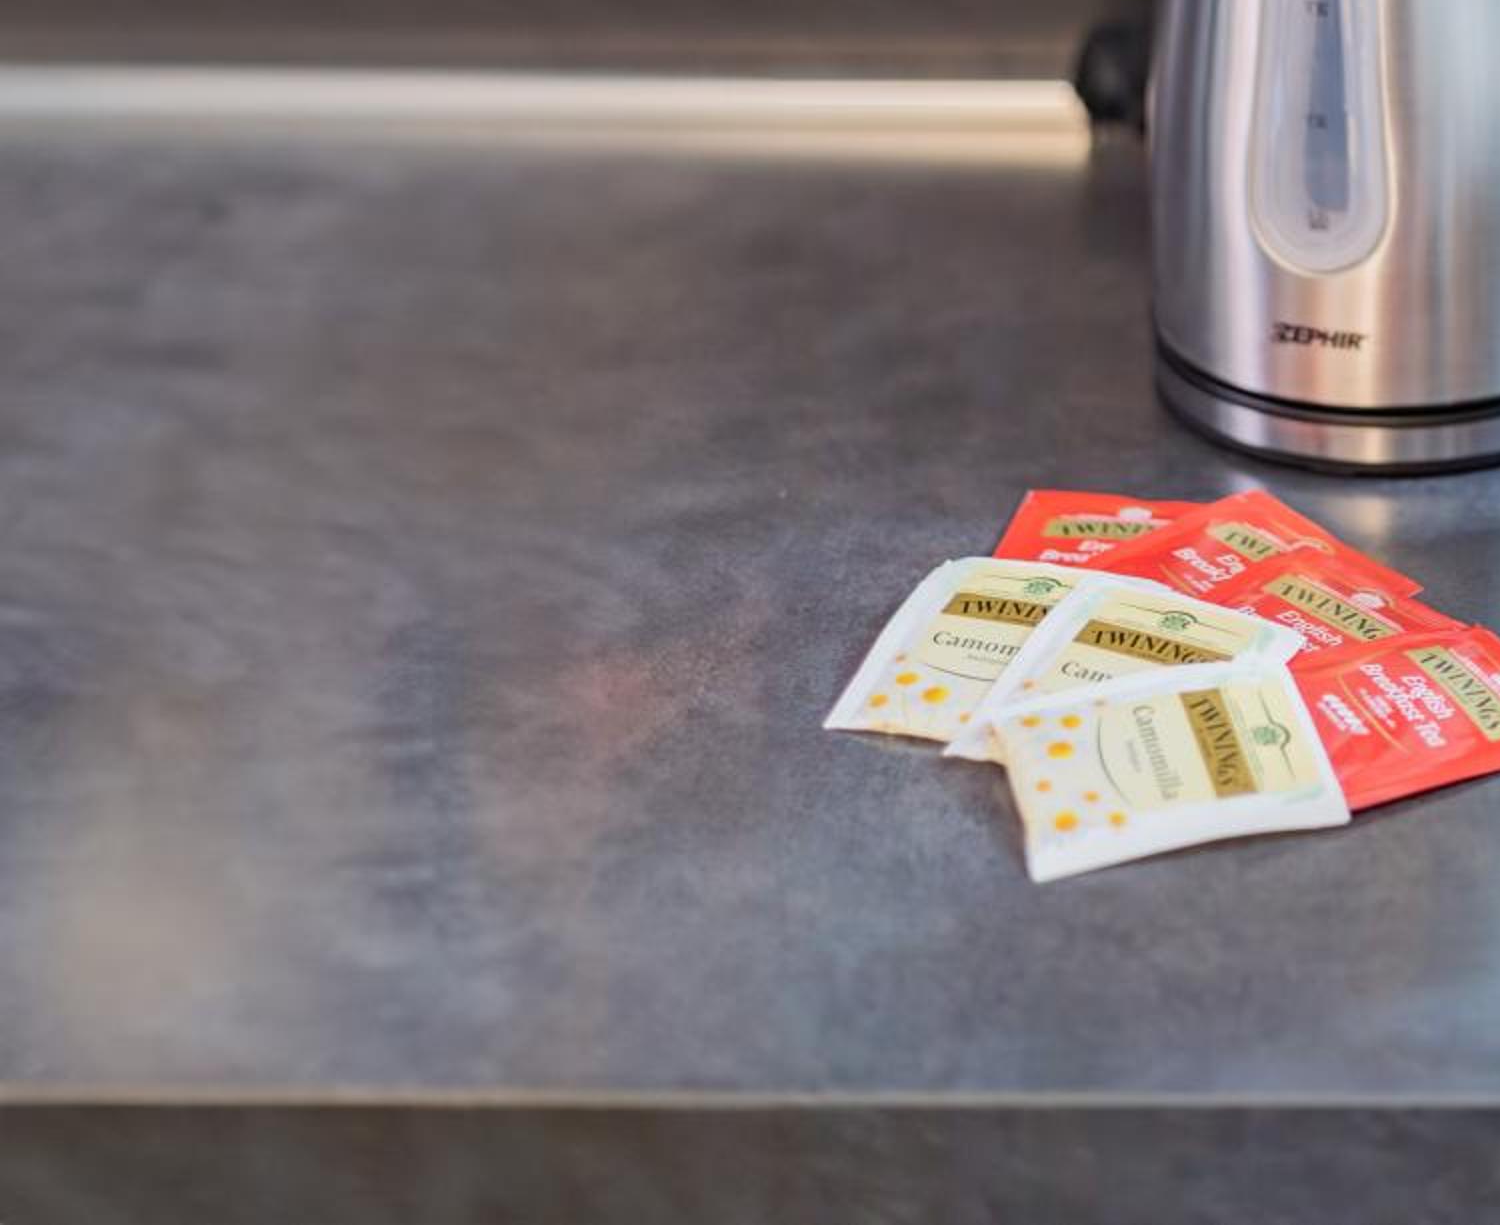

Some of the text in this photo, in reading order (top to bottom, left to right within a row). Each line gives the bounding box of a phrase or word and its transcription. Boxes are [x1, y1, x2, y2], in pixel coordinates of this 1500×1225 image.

[1272, 322, 1364, 350] ZEPHIR
[1420, 653, 1500, 730] TWININGS
[1189, 698, 1238, 786] TWININGS
